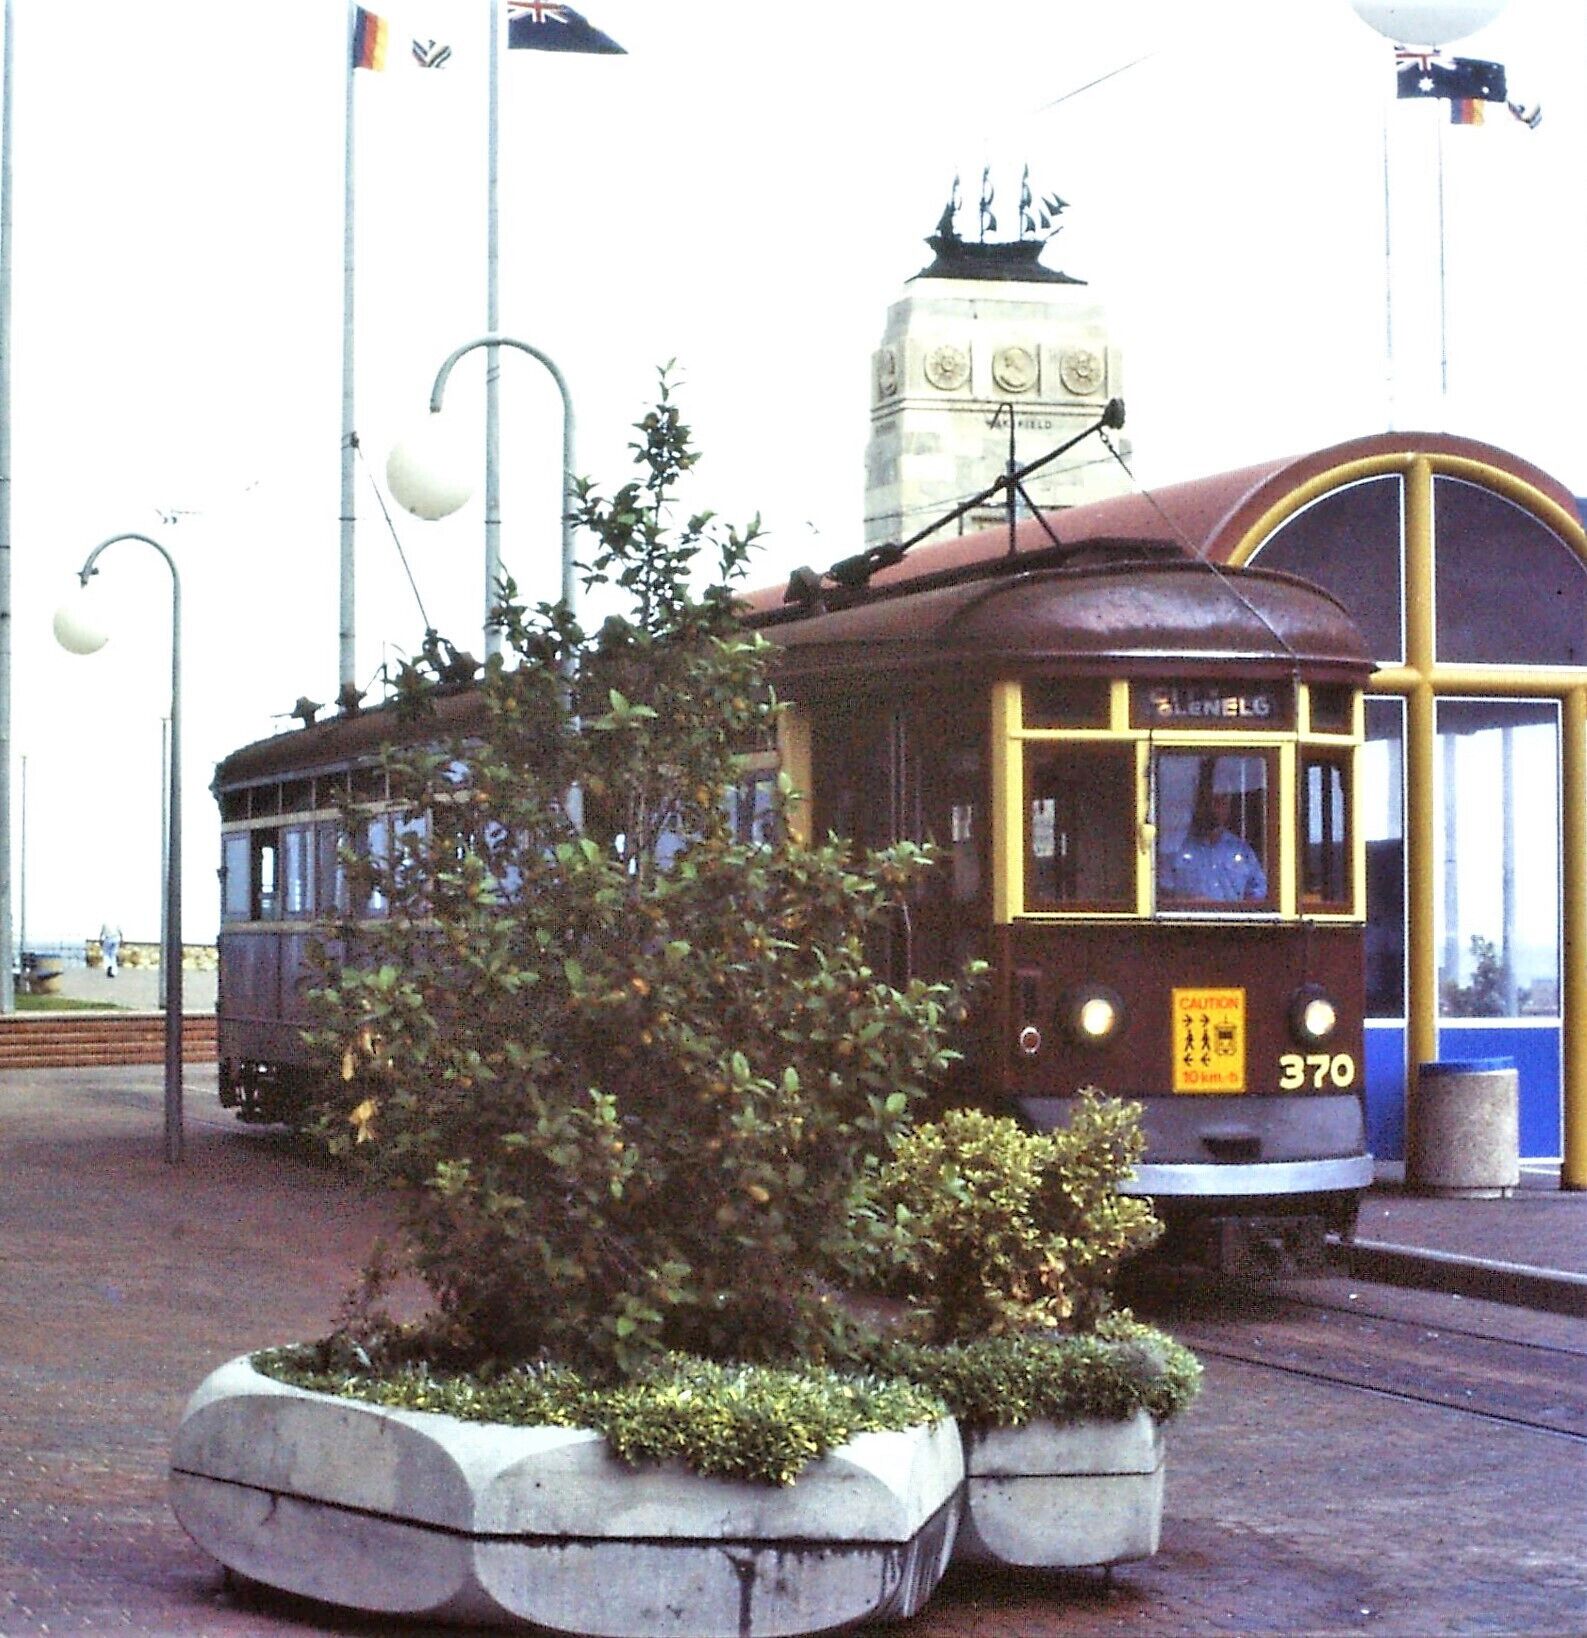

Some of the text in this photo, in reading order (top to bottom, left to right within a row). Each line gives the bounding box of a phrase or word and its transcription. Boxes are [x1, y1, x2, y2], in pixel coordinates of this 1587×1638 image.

[986, 420, 1052, 430] AKFIELD
[1179, 996, 1239, 1010] CAUTION
[1279, 1053, 1355, 1090] 370
